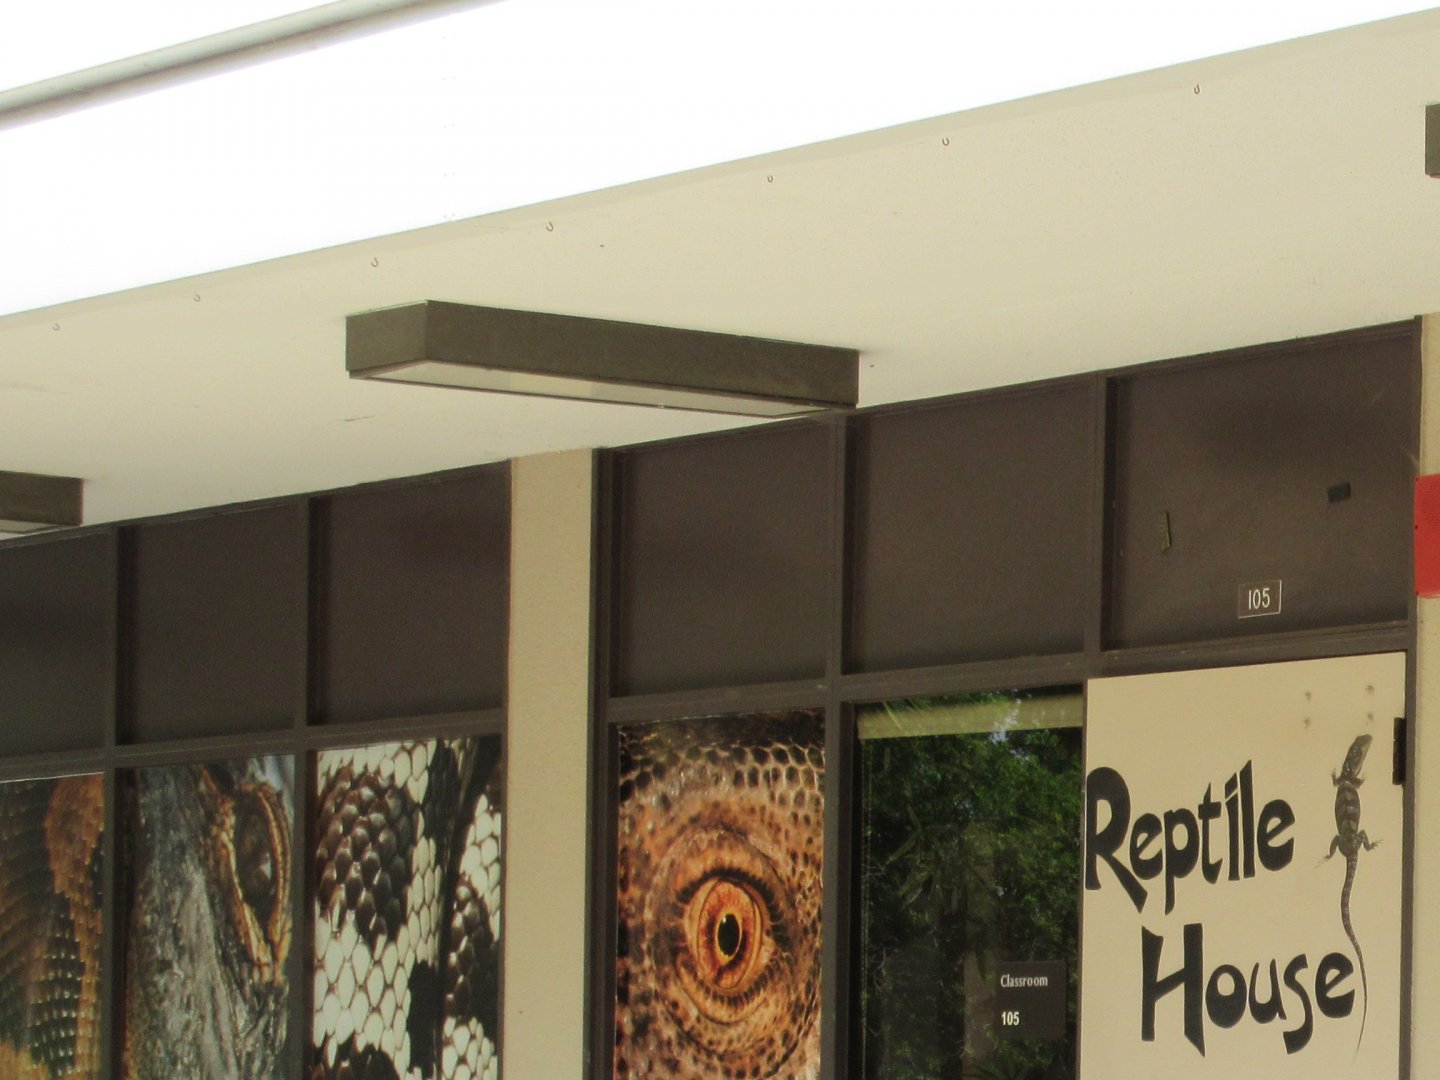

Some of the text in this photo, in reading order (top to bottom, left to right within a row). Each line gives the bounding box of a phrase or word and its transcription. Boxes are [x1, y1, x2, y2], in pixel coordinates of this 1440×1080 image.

[1248, 587, 1271, 610] 105
[1085, 759, 1296, 916] Reptile
[1000, 973, 1049, 988] Classroom
[1141, 922, 1356, 1058] House
[1001, 1011, 1020, 1026] 105
